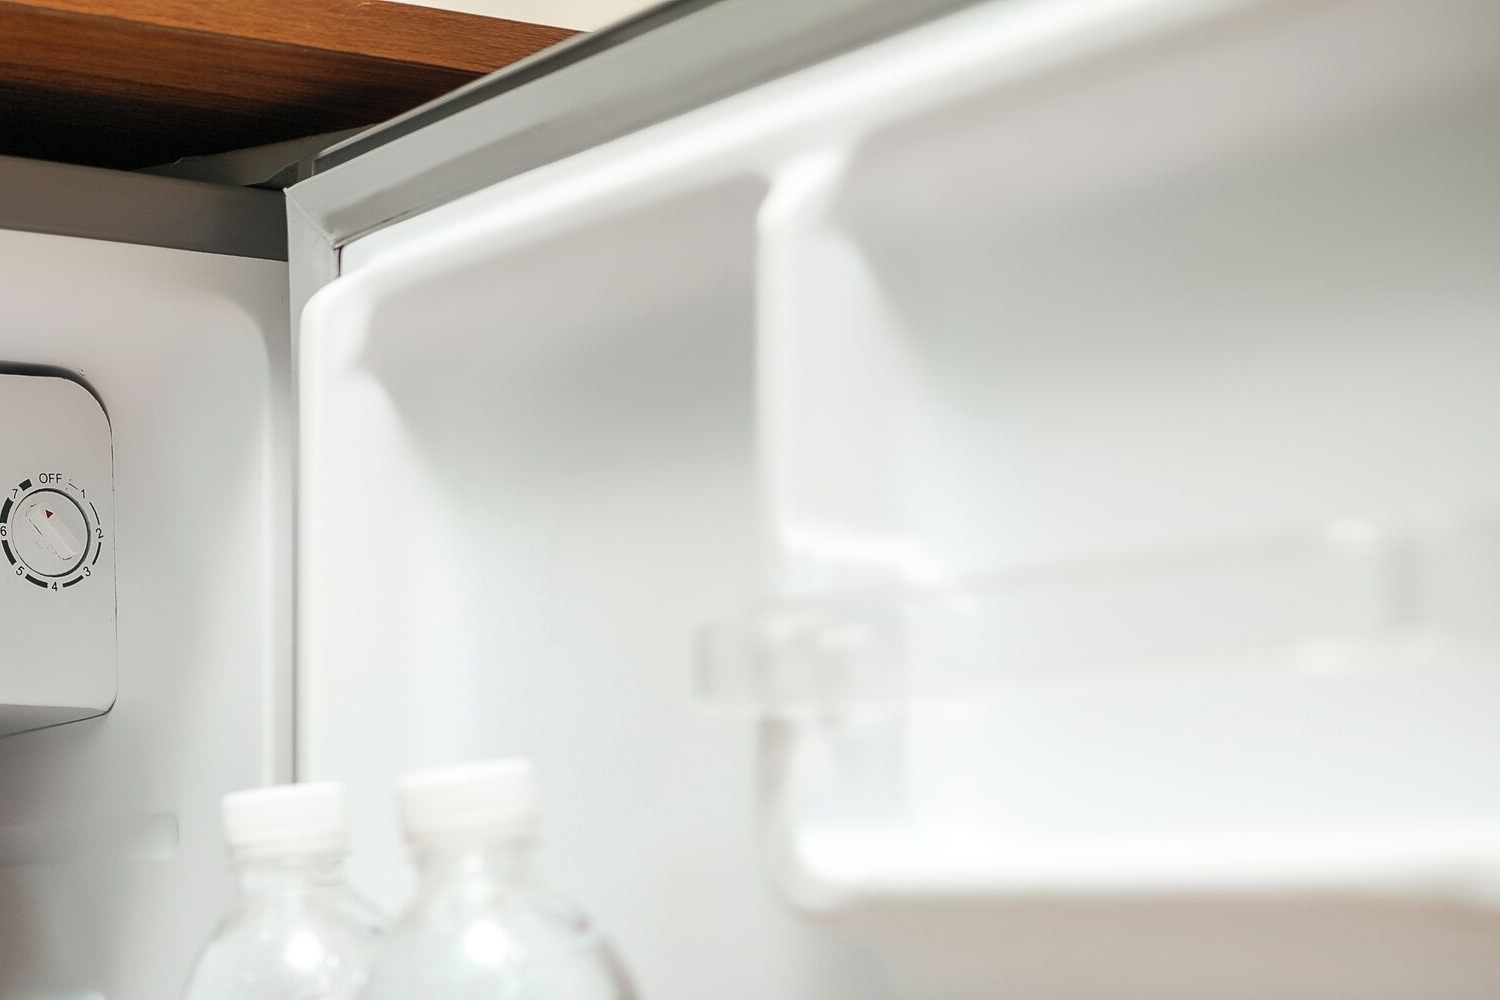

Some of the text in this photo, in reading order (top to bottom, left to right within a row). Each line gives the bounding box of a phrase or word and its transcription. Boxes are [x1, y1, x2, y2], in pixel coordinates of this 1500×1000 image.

[38, 472, 63, 484] OFF
[11, 488, 19, 499] 7
[80, 489, 86, 499] 1
[0, 525, 7, 537] 6
[95, 528, 104, 539] 2
[15, 566, 25, 576] 5
[82, 566, 92, 577] 3
[51, 581, 58, 592] 4
